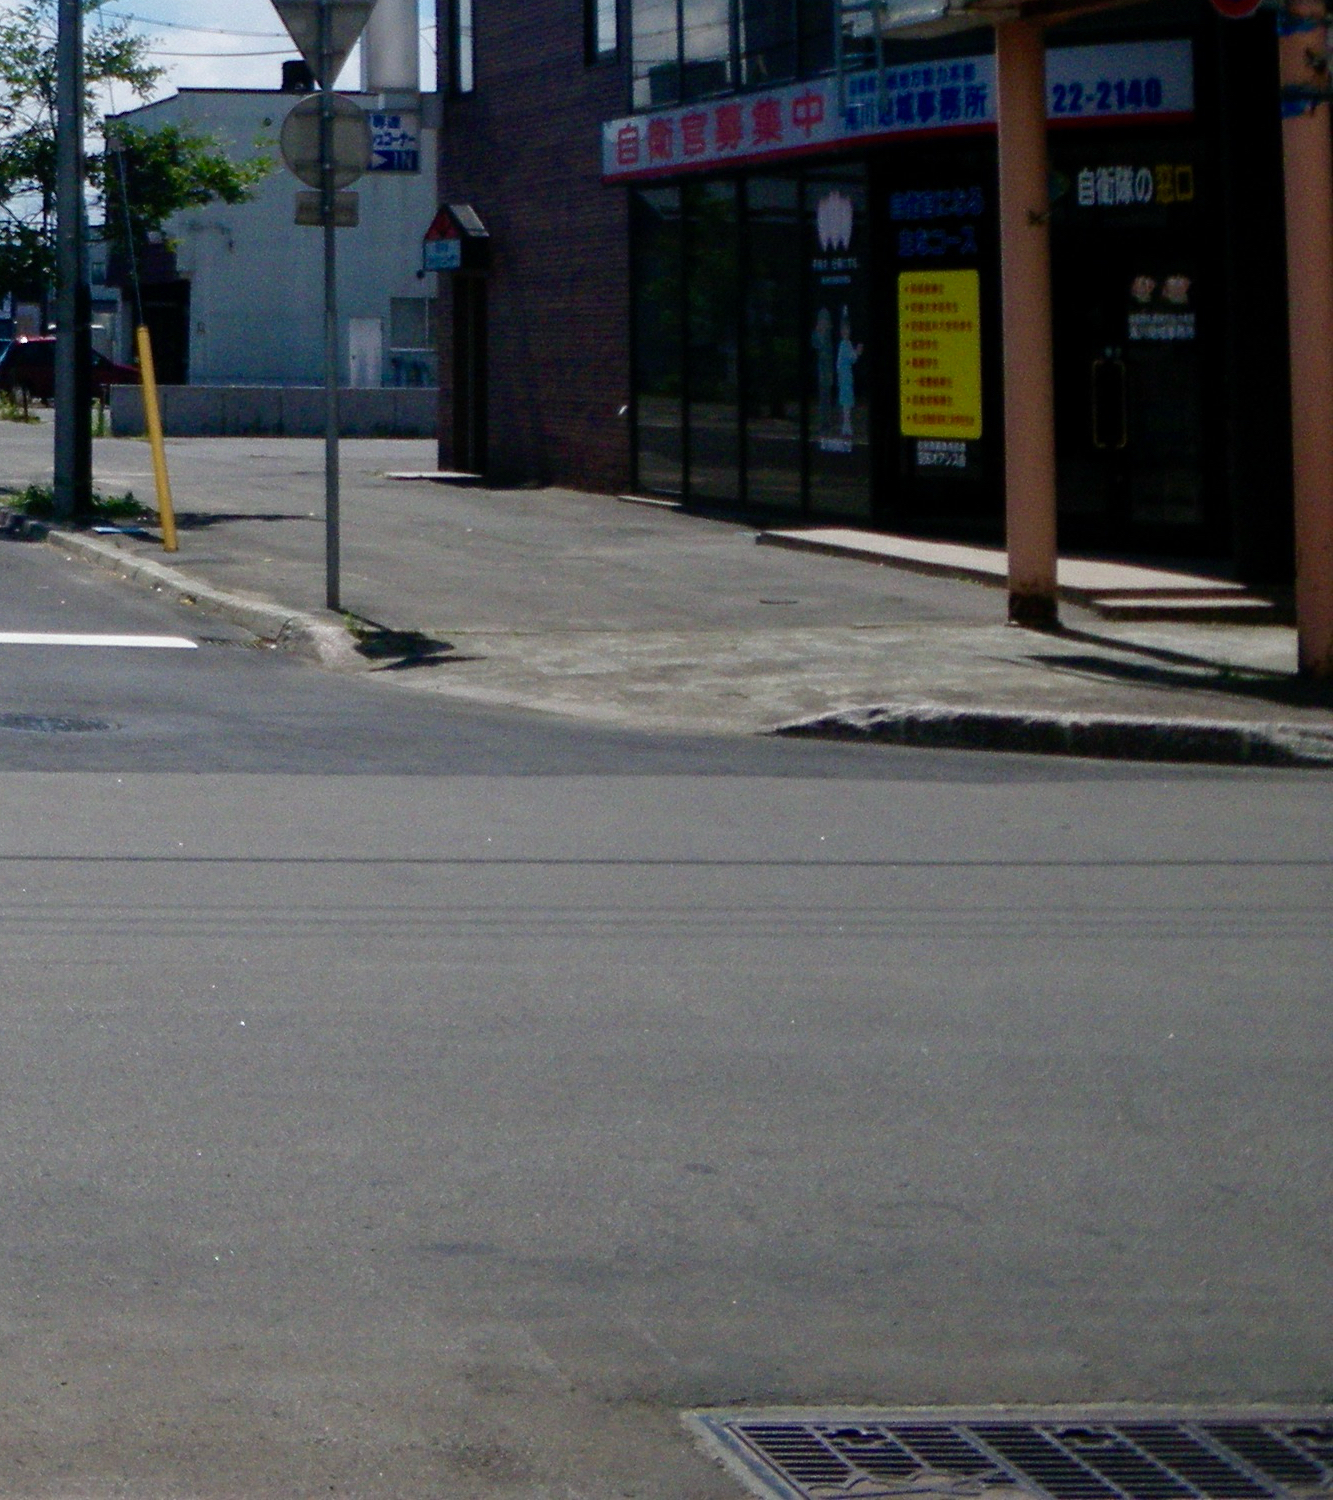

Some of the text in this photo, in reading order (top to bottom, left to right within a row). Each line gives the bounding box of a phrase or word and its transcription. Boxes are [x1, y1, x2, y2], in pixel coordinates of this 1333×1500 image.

[616, 88, 826, 166] 自衛官募集中
[1076, 162, 1196, 206] 自衛隊の窓口
